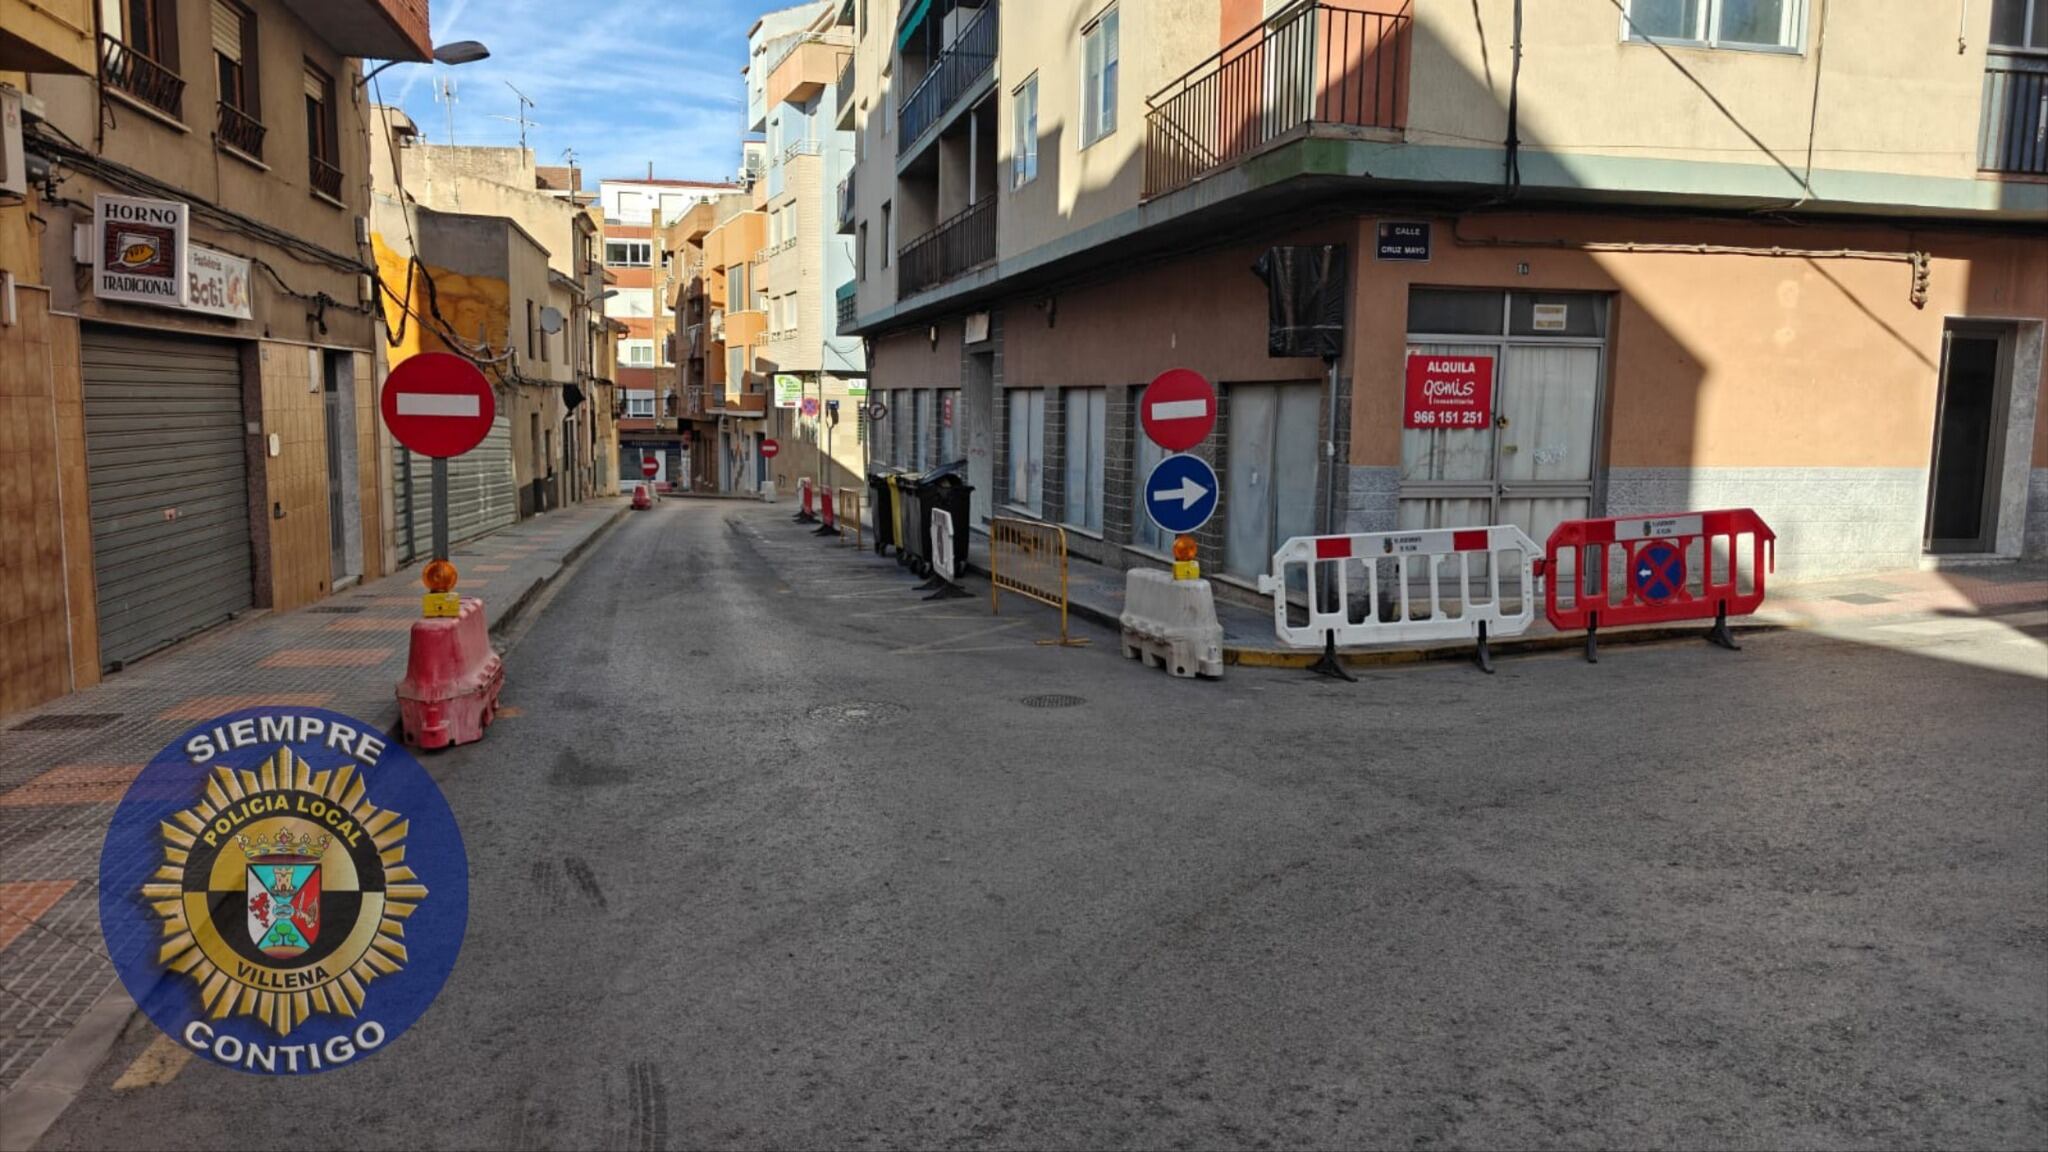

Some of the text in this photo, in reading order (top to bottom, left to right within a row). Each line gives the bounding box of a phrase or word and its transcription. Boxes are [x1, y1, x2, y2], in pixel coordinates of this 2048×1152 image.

[105, 203, 177, 225] HORNO
[1395, 227, 1421, 236] CALLE
[1381, 246, 1426, 255] CRUZ MAYO
[103, 275, 176, 297] TRADICIONAL
[1427, 361, 1476, 374] ALQUILA
[1413, 411, 1483, 424] 966 151 251
